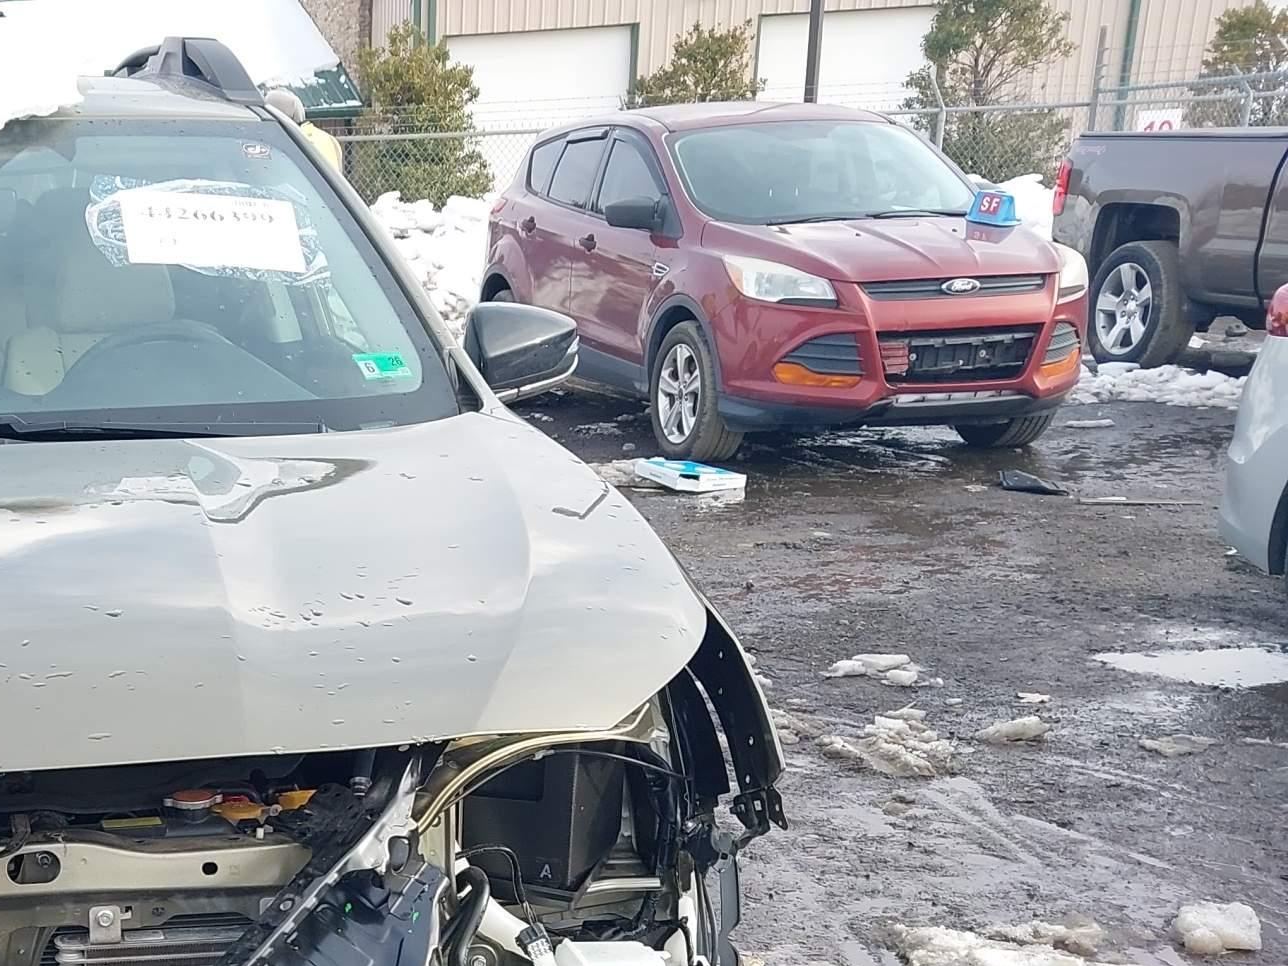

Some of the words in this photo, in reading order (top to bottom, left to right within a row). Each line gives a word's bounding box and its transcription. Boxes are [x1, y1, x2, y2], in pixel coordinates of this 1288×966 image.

[980, 196, 1001, 213] SF
[951, 280, 973, 292] Ford
[540, 863, 552, 879] A
